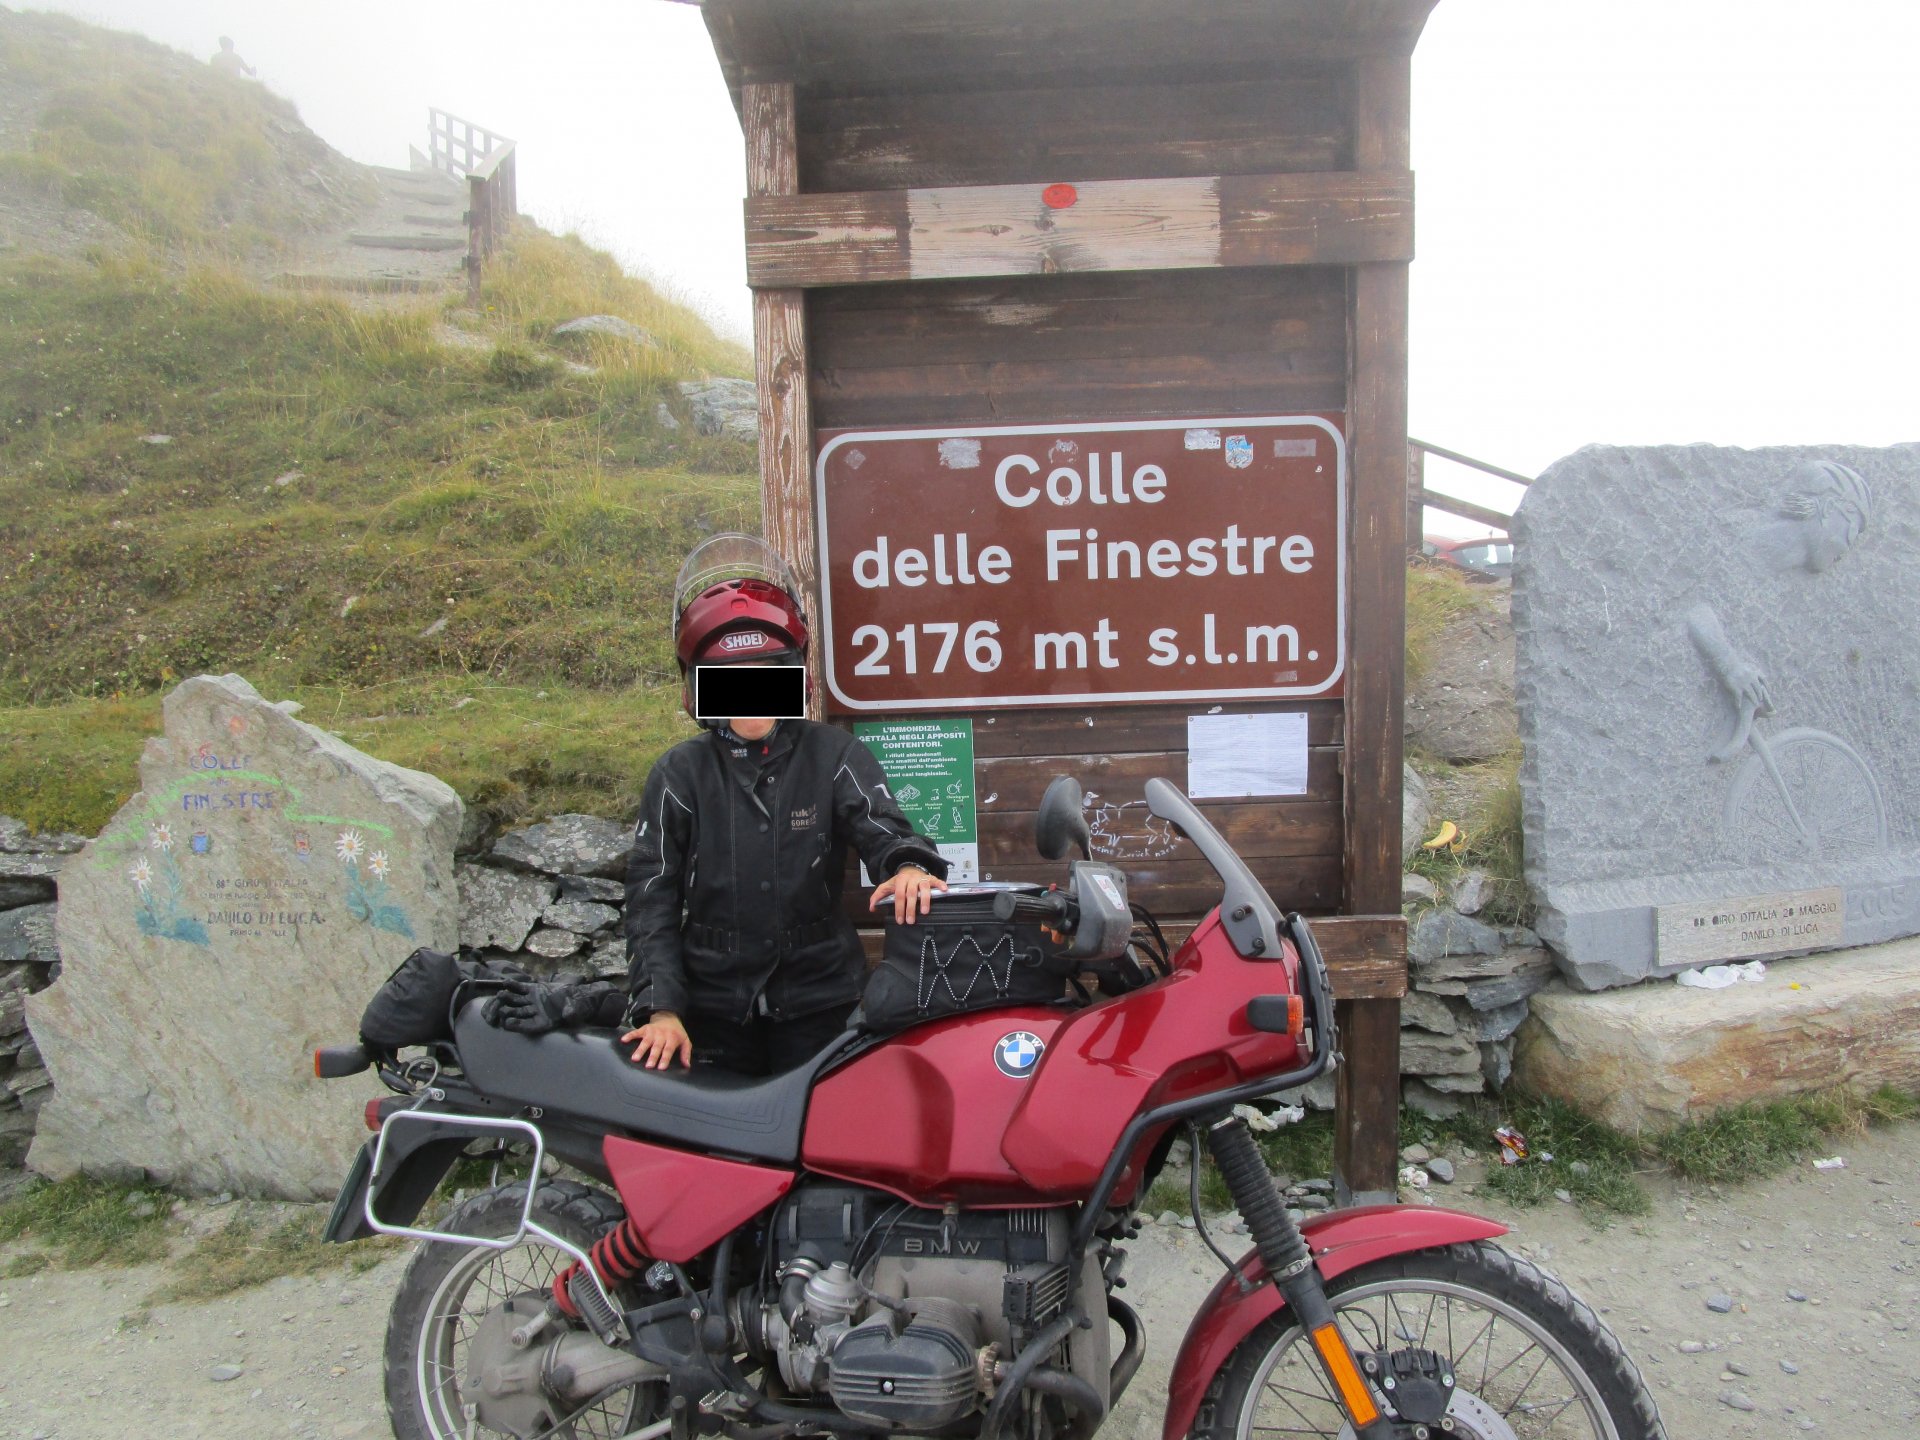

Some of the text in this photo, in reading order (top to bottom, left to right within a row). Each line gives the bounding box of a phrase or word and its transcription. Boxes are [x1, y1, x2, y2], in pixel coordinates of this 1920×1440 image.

[994, 451, 1167, 508] Colle
[852, 524, 1315, 589] delle Finestre
[725, 632, 763, 649] SHOEI
[851, 613, 1319, 677] 2176 mt s.l.m.
[882, 725, 942, 734] L'IMMONDIZIA
[899, 733, 925, 741] NEGLI
[926, 732, 966, 740] APPOSITI
[882, 741, 943, 749] CONTENITORI.
[207, 911, 253, 925] DANILO
[1712, 914, 1736, 926] GIRO
[1799, 902, 1837, 916] MAGGIO
[1741, 923, 1819, 942] DANILO DI LUCA
[999, 1033, 1042, 1048] BMW
[904, 1238, 981, 1255] BMW
